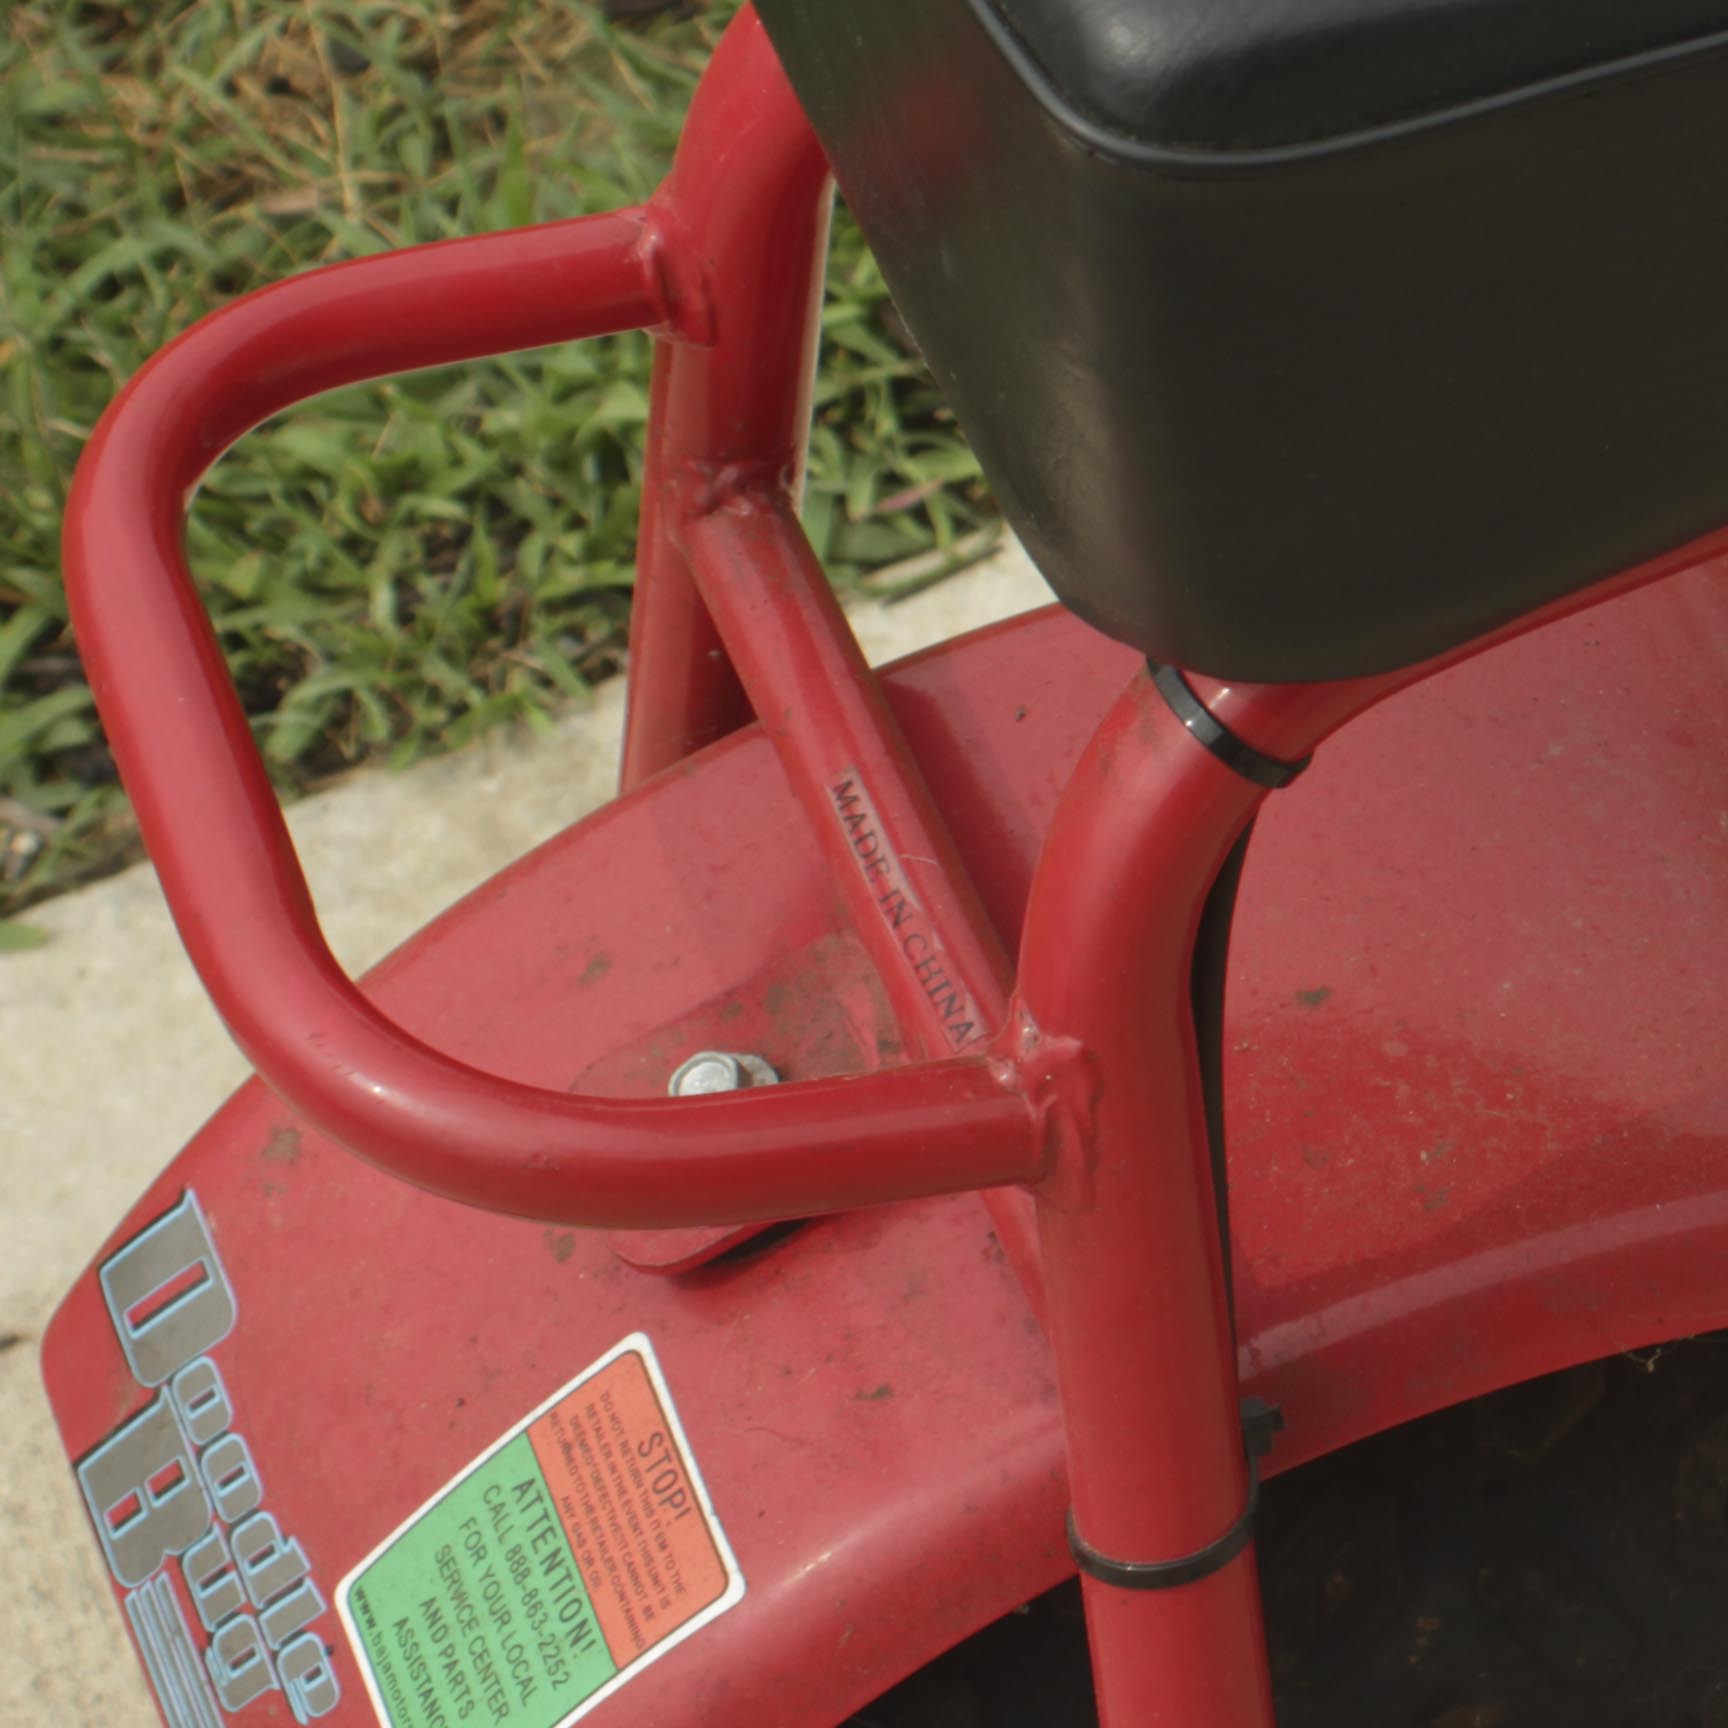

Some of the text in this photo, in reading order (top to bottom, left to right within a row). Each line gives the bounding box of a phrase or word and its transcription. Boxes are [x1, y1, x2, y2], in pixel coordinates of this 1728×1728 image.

[832, 779, 977, 1045] MADE IN CHINA
[597, 1389, 615, 1414] DO
[605, 1409, 625, 1440] NOT
[99, 1187, 341, 1724] Doodle
[571, 1473, 586, 1495] TO
[584, 1403, 613, 1461] RETAILER
[610, 1472, 628, 1499] THE
[621, 1498, 643, 1539] EVENT
[635, 1537, 656, 1569] THIS
[618, 1439, 644, 1489] RETURN
[635, 1428, 692, 1526] STOP!
[558, 1492, 578, 1522] ANY
[569, 1519, 588, 1550] GAS
[579, 1547, 596, 1571] OR
[577, 1491, 596, 1520] THE
[636, 1487, 657, 1520] THIS
[74, 1383, 282, 1714] Bug
[480, 1482, 572, 1690] CALL 888-863-2252
[509, 1473, 598, 1659] ATTENTION!
[621, 1550, 647, 1602] CANNOT
[640, 1603, 656, 1624] BE
[661, 1551, 677, 1574] TO
[668, 1569, 687, 1598] THE
[430, 1543, 514, 1724] SERVICE CENTER
[458, 1515, 541, 1707] FOR YOUR LOCAL
[610, 1574, 645, 1649] CONTAINING
[418, 1595, 479, 1720] AND PARTS
